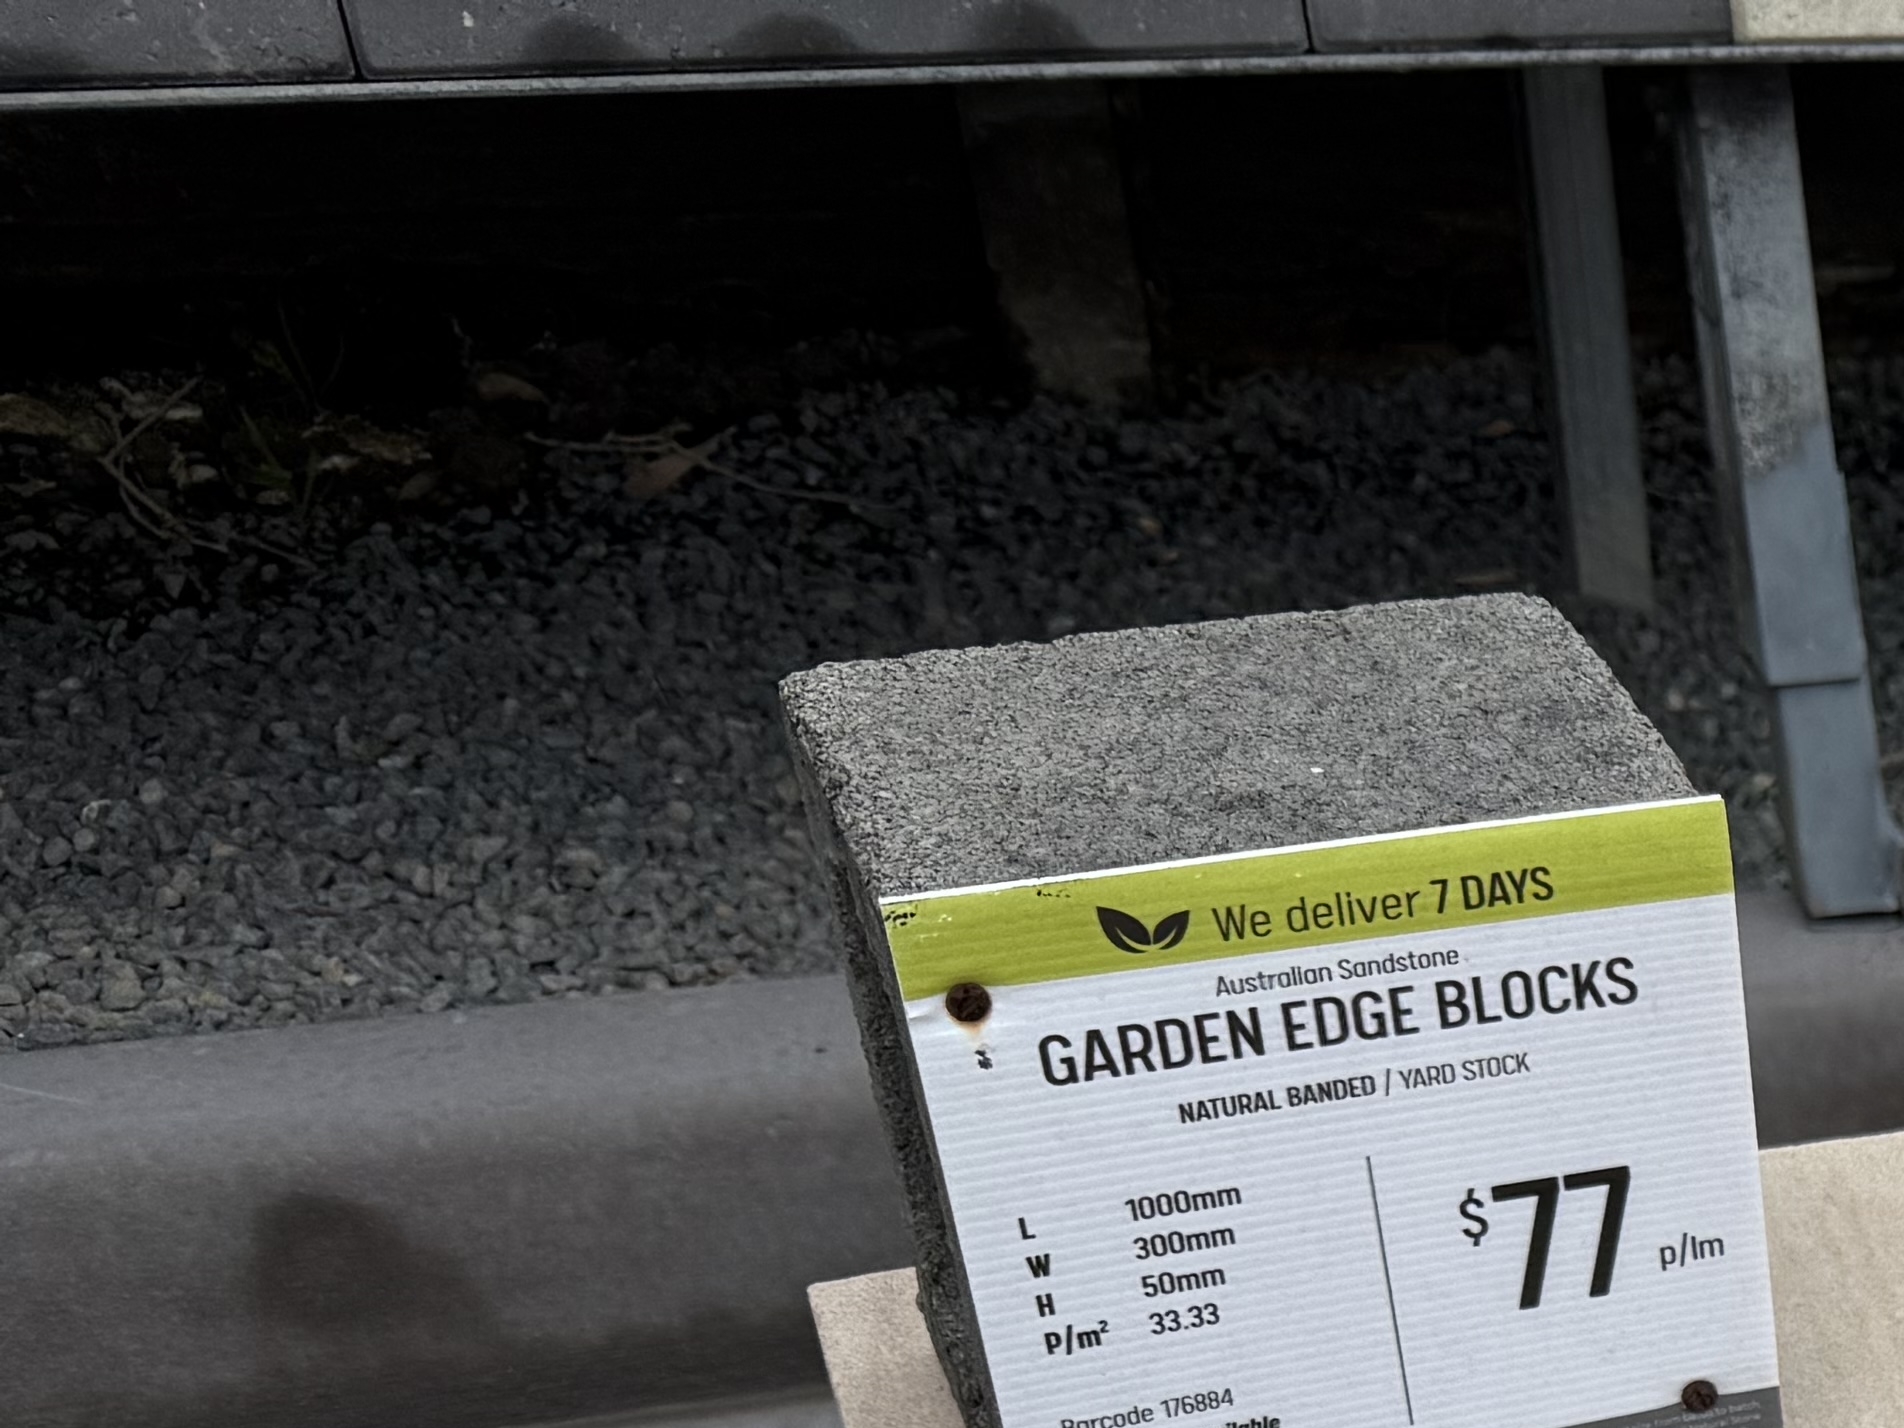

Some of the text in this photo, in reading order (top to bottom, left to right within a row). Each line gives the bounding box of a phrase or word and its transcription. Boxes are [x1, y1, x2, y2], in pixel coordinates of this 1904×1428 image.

[1211, 867, 1553, 941] We deliver 7 DAYS
[1216, 950, 1459, 997] Australian Sandstone
[1038, 957, 1638, 1086] GARDEN EDGE BLOCKS
[1178, 1052, 1530, 1123] NATURAL BANDED / YARD STOCK
[1018, 1188, 1242, 1240] L 1000mm
[1459, 1166, 1631, 1310] $77
[1026, 1228, 1235, 1278] W 300mm
[1036, 1269, 1226, 1317] H 50mm
[1044, 1303, 1219, 1355] P/m² 33.33
[1160, 1388, 1233, 1418] 176884
